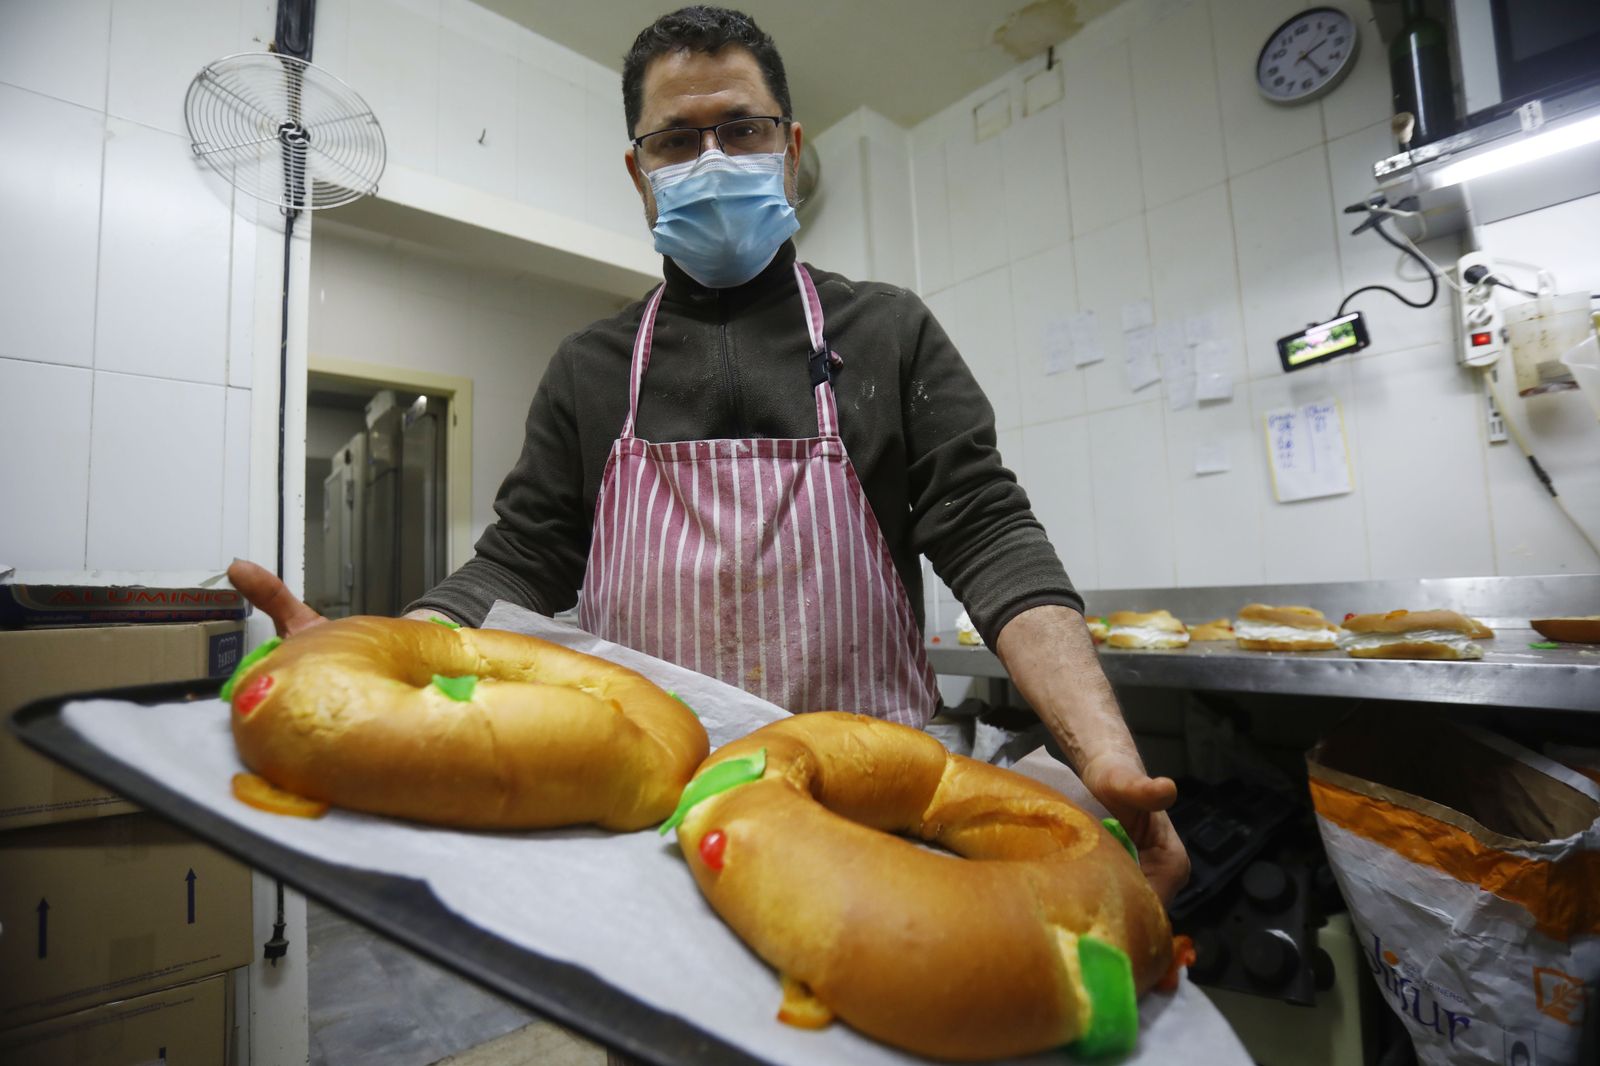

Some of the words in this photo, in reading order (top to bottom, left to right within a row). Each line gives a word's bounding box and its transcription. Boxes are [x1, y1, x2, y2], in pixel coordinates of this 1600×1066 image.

[1272, 48, 1287, 60] 10
[1286, 81, 1296, 92] 7
[51, 590, 240, 605] ALUMINIO
